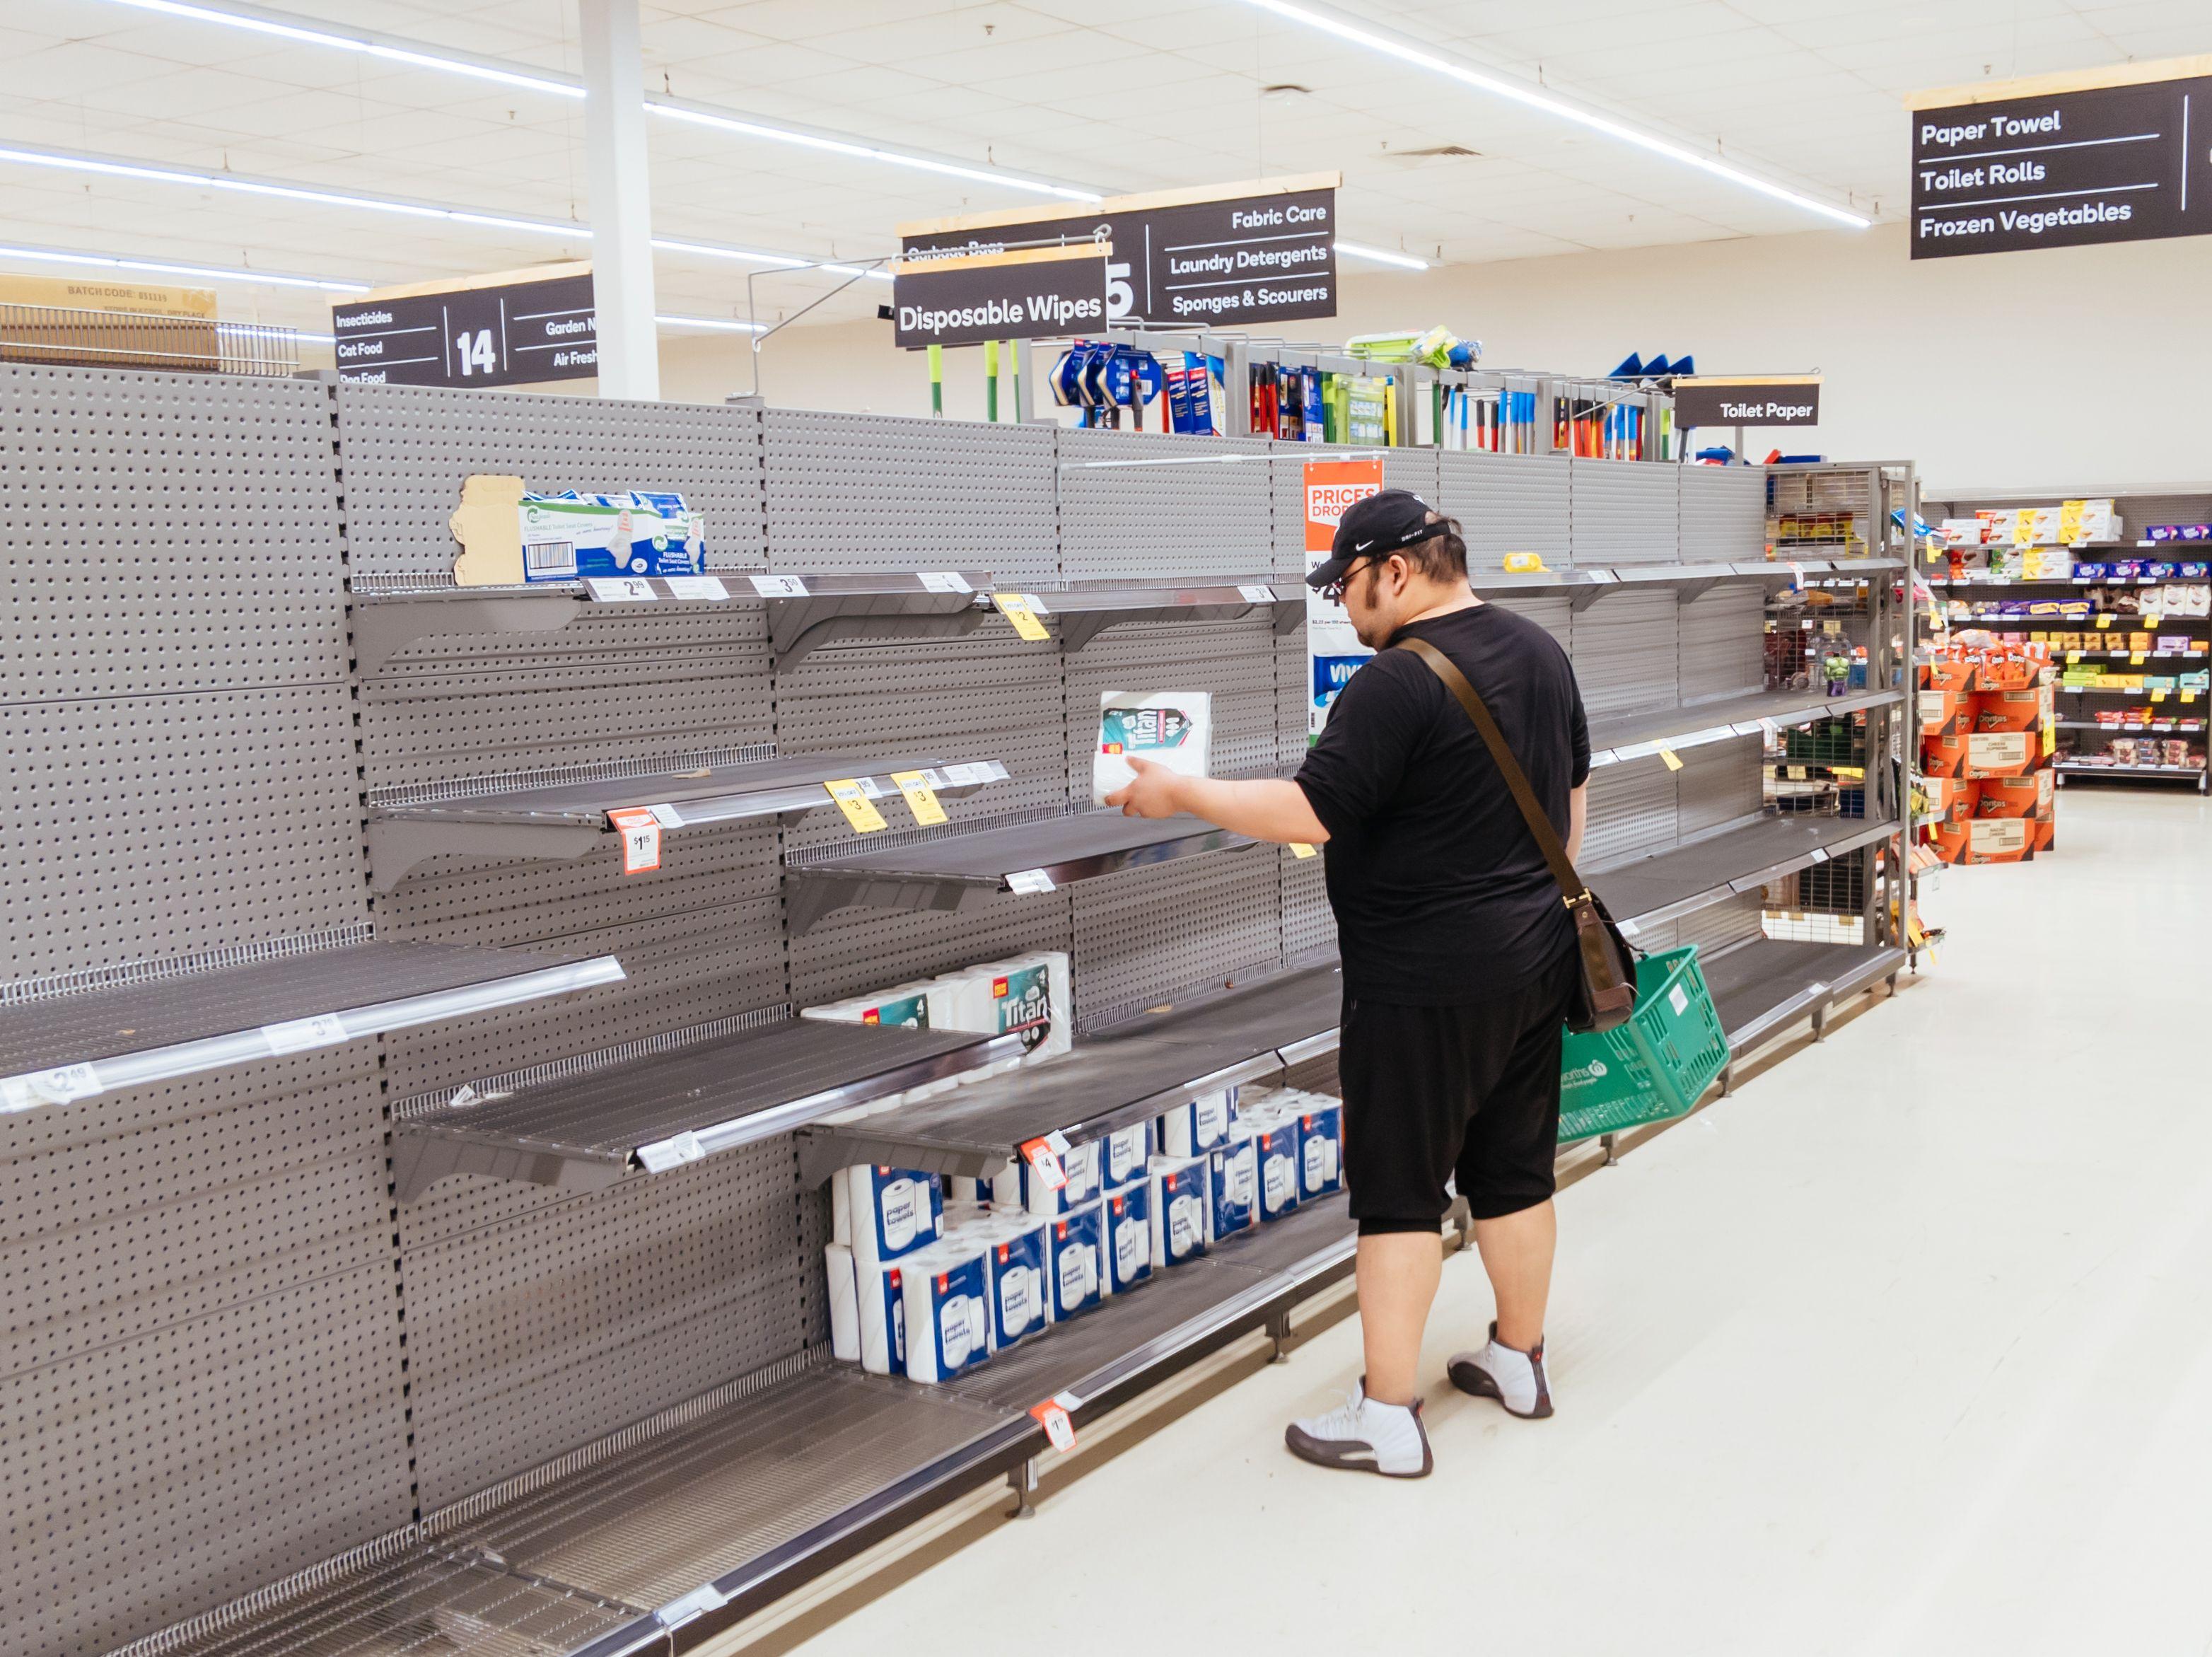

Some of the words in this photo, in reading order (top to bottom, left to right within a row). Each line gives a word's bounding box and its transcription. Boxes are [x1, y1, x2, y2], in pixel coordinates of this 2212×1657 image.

[1922, 123, 1987, 147] Paper
[1991, 110, 2061, 137] Towel
[1920, 168, 1984, 191] Toilet
[1989, 161, 2046, 185] Rolls
[1232, 209, 1283, 229] Fabric
[1286, 205, 1327, 223] Care
[1920, 217, 1994, 238] Frozen
[2000, 202, 2132, 233] Vegetables
[1170, 253, 1234, 274] Laundry
[1238, 245, 1327, 268] Detergents
[67, 286, 103, 296] BATCH
[105, 287, 136, 298] CODE:
[1107, 262, 1134, 318] 5
[1172, 293, 1240, 316] Sponges
[1242, 290, 1255, 307] &
[1257, 287, 1328, 303] Scourers
[336, 311, 392, 327] Insecticides
[900, 298, 1023, 335] Disposable
[1027, 294, 1101, 326] Wipes
[545, 320, 586, 335] Garden
[338, 344, 357, 357] Cat
[358, 341, 383, 355] Food
[457, 329, 496, 376] 14
[554, 352, 569, 366] Air
[570, 349, 598, 365] Fresh
[361, 371, 386, 383] Food
[1720, 402, 1764, 419] Toilet
[1766, 402, 1813, 421] Paper
[1312, 506, 1349, 517] DROP
[1126, 709, 1158, 750] Titan
[1001, 995, 1048, 1028] Titan
[886, 1202, 911, 1217] paper
[887, 1210, 914, 1226] towels
[1005, 1288, 1025, 1303] paper
[1006, 1297, 1028, 1312] towels
[945, 1318, 965, 1334] paper
[945, 1328, 970, 1344] towels
